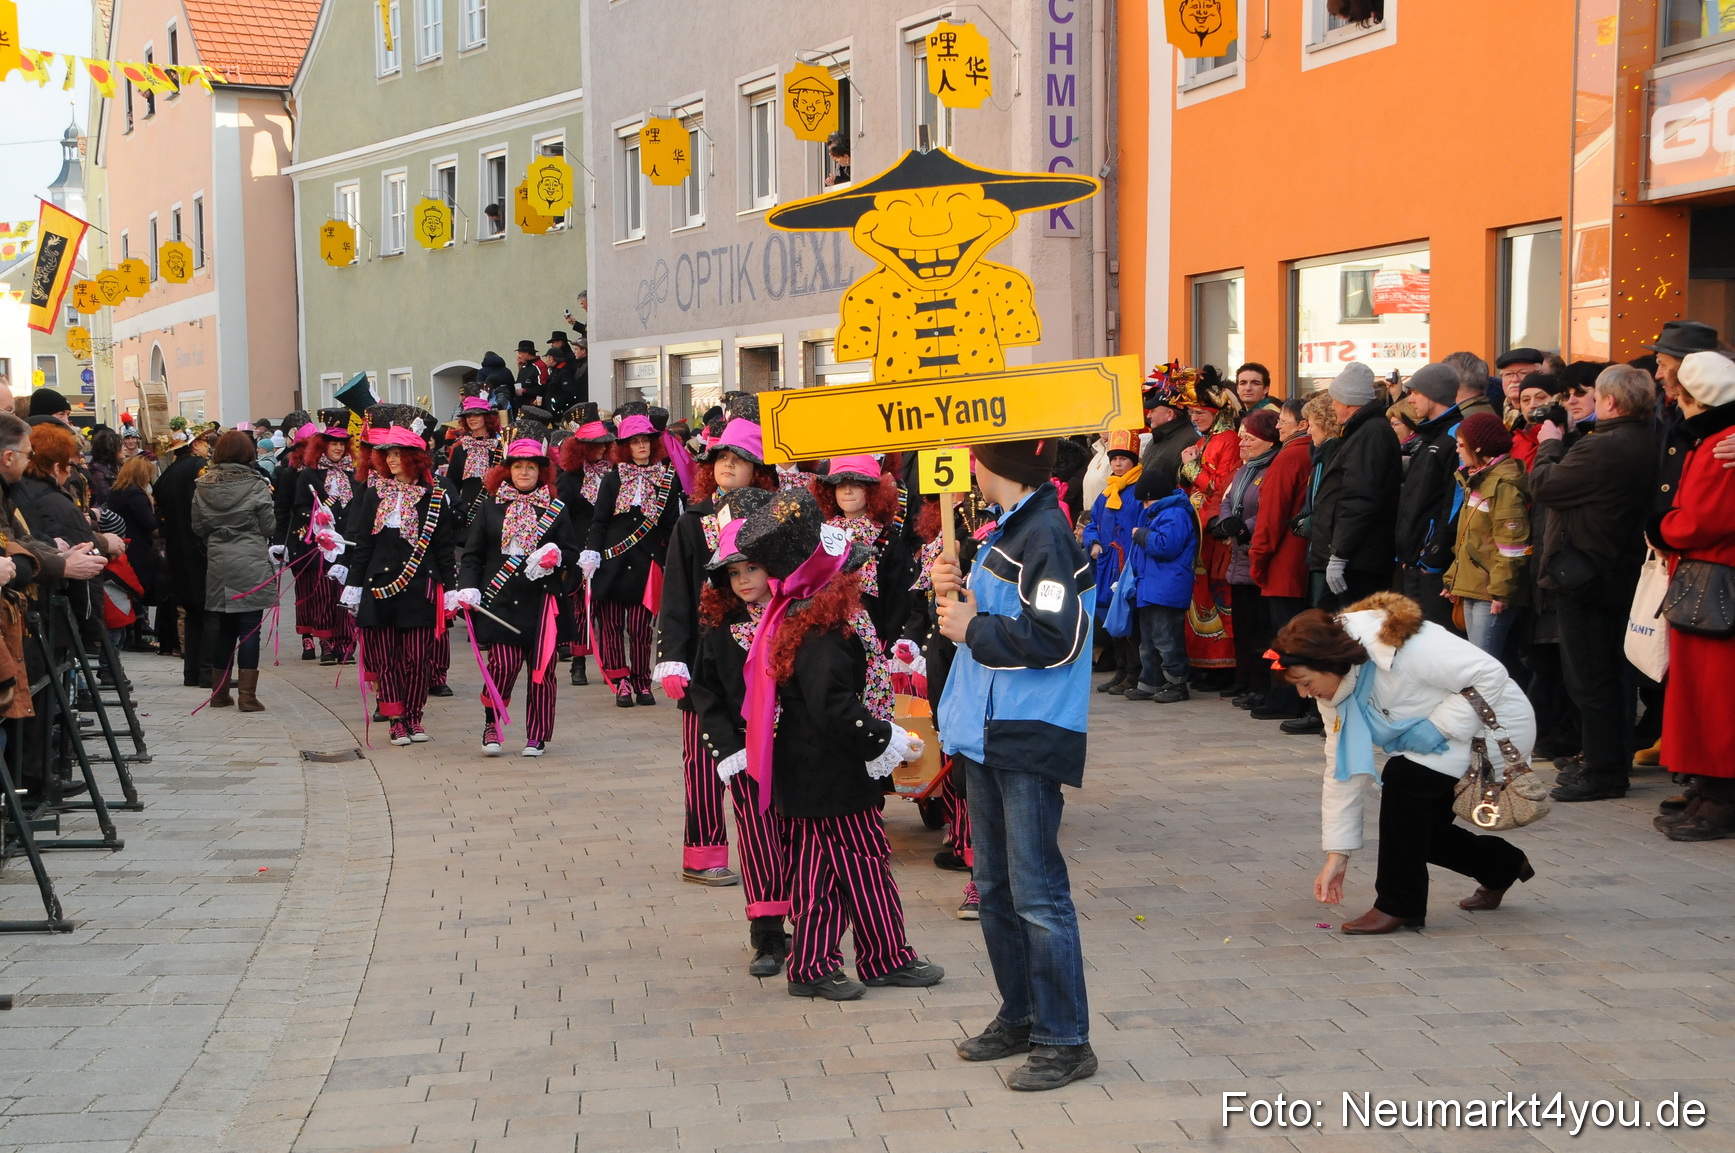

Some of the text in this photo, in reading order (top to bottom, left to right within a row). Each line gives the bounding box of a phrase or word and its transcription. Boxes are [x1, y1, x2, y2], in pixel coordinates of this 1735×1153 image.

[675, 231, 854, 312] OPTIK OEXL
[877, 395, 1007, 433] Yin-Yang
[933, 456, 955, 487] 5
[1472, 803, 1501, 827] G
